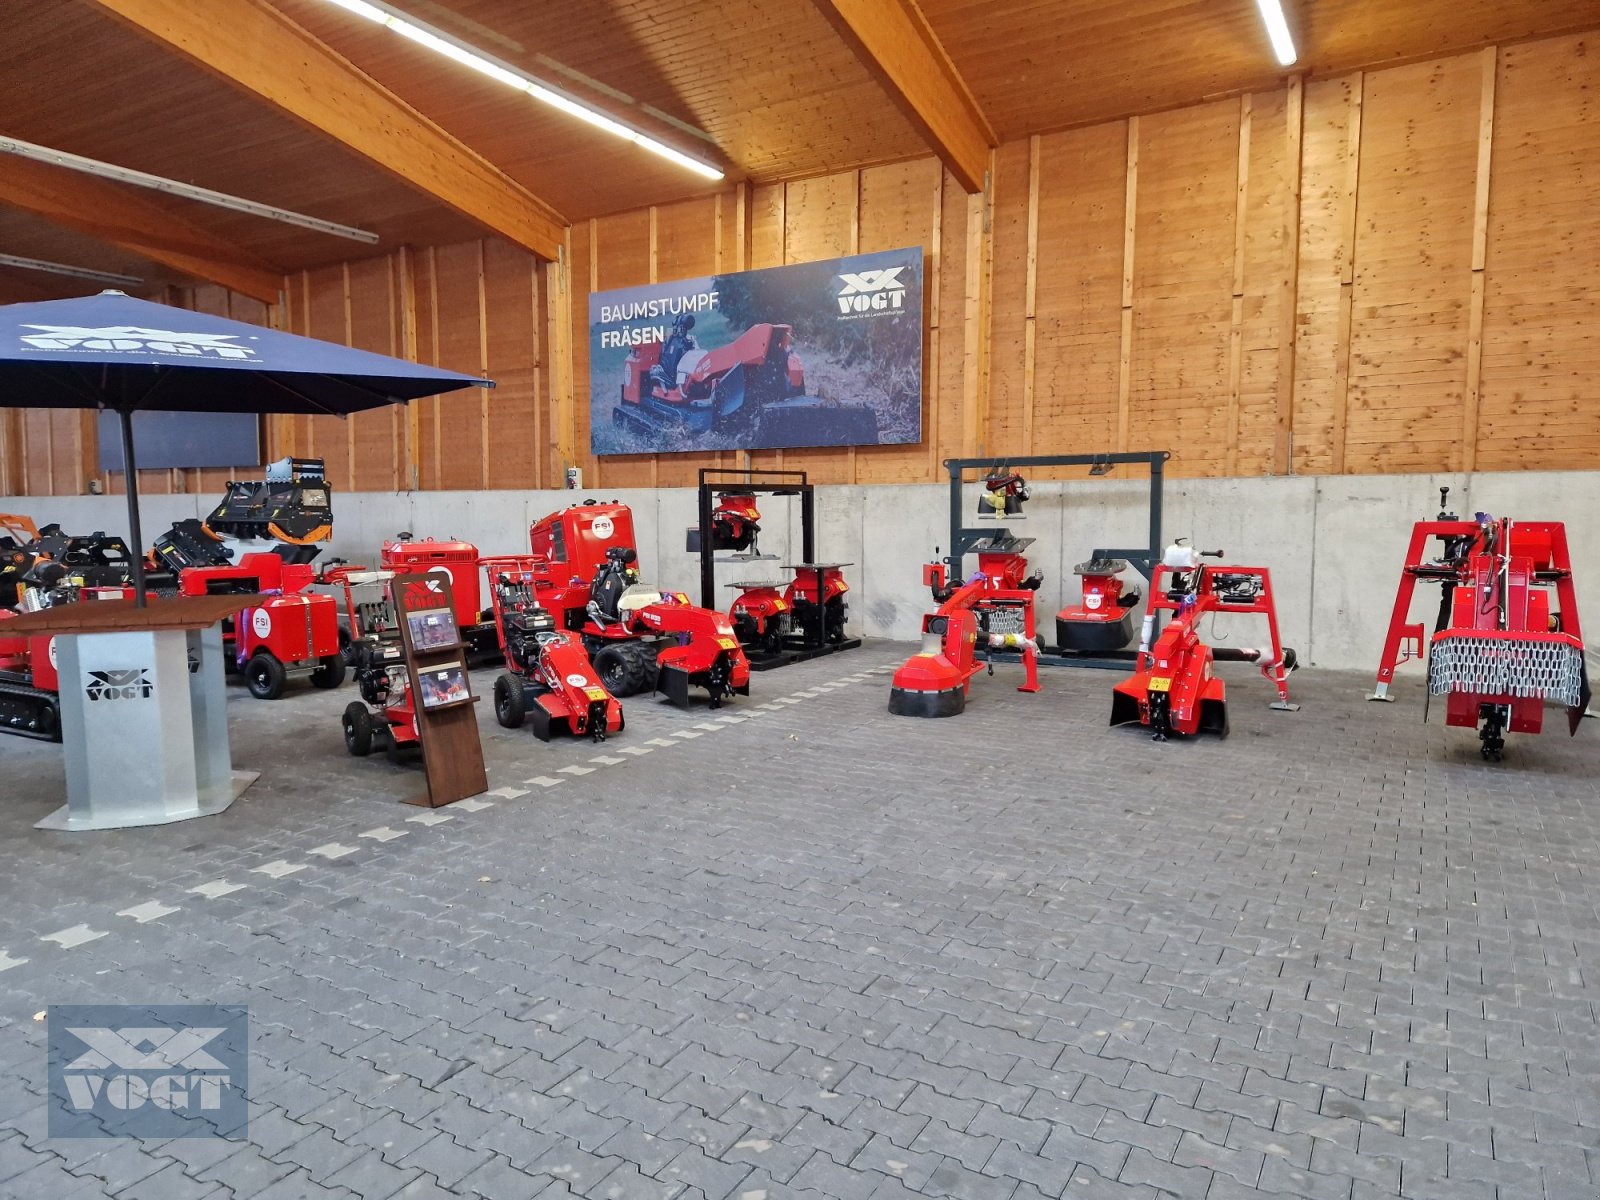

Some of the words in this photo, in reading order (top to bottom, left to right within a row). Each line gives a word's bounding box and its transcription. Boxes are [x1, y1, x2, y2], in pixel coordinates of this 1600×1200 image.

[601, 291, 719, 324] BAUMSTUMPF
[837, 289, 906, 314] VOGT
[20, 337, 256, 359] VOGT
[601, 325, 665, 349] FRÄSEN
[255, 617, 268, 627] FSI
[86, 685, 154, 702] VOGT
